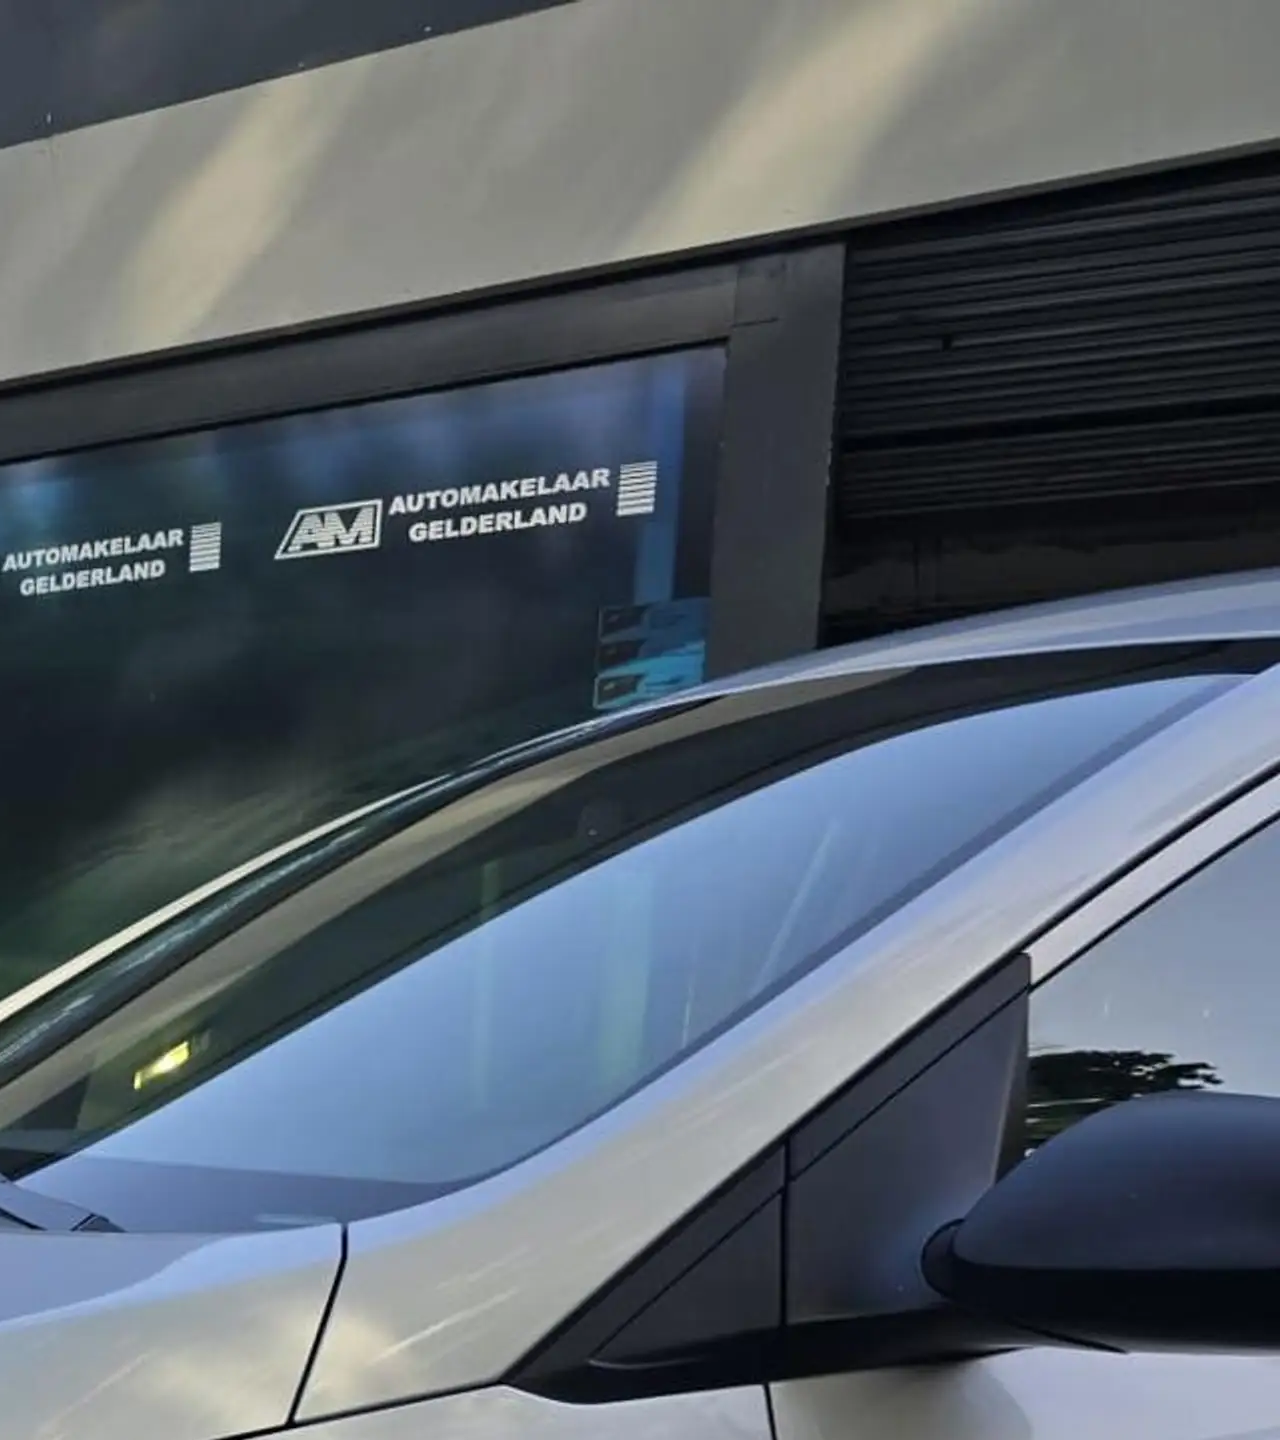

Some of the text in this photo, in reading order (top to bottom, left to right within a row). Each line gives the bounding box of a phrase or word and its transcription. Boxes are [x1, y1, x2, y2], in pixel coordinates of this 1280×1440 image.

[388, 466, 611, 516] AUTOMAKELAAR
[290, 507, 375, 552] AM
[408, 502, 588, 543] GELDERLAND
[2, 528, 185, 572] AUTOMAKELAAR
[19, 560, 167, 597] GELDERLAND
